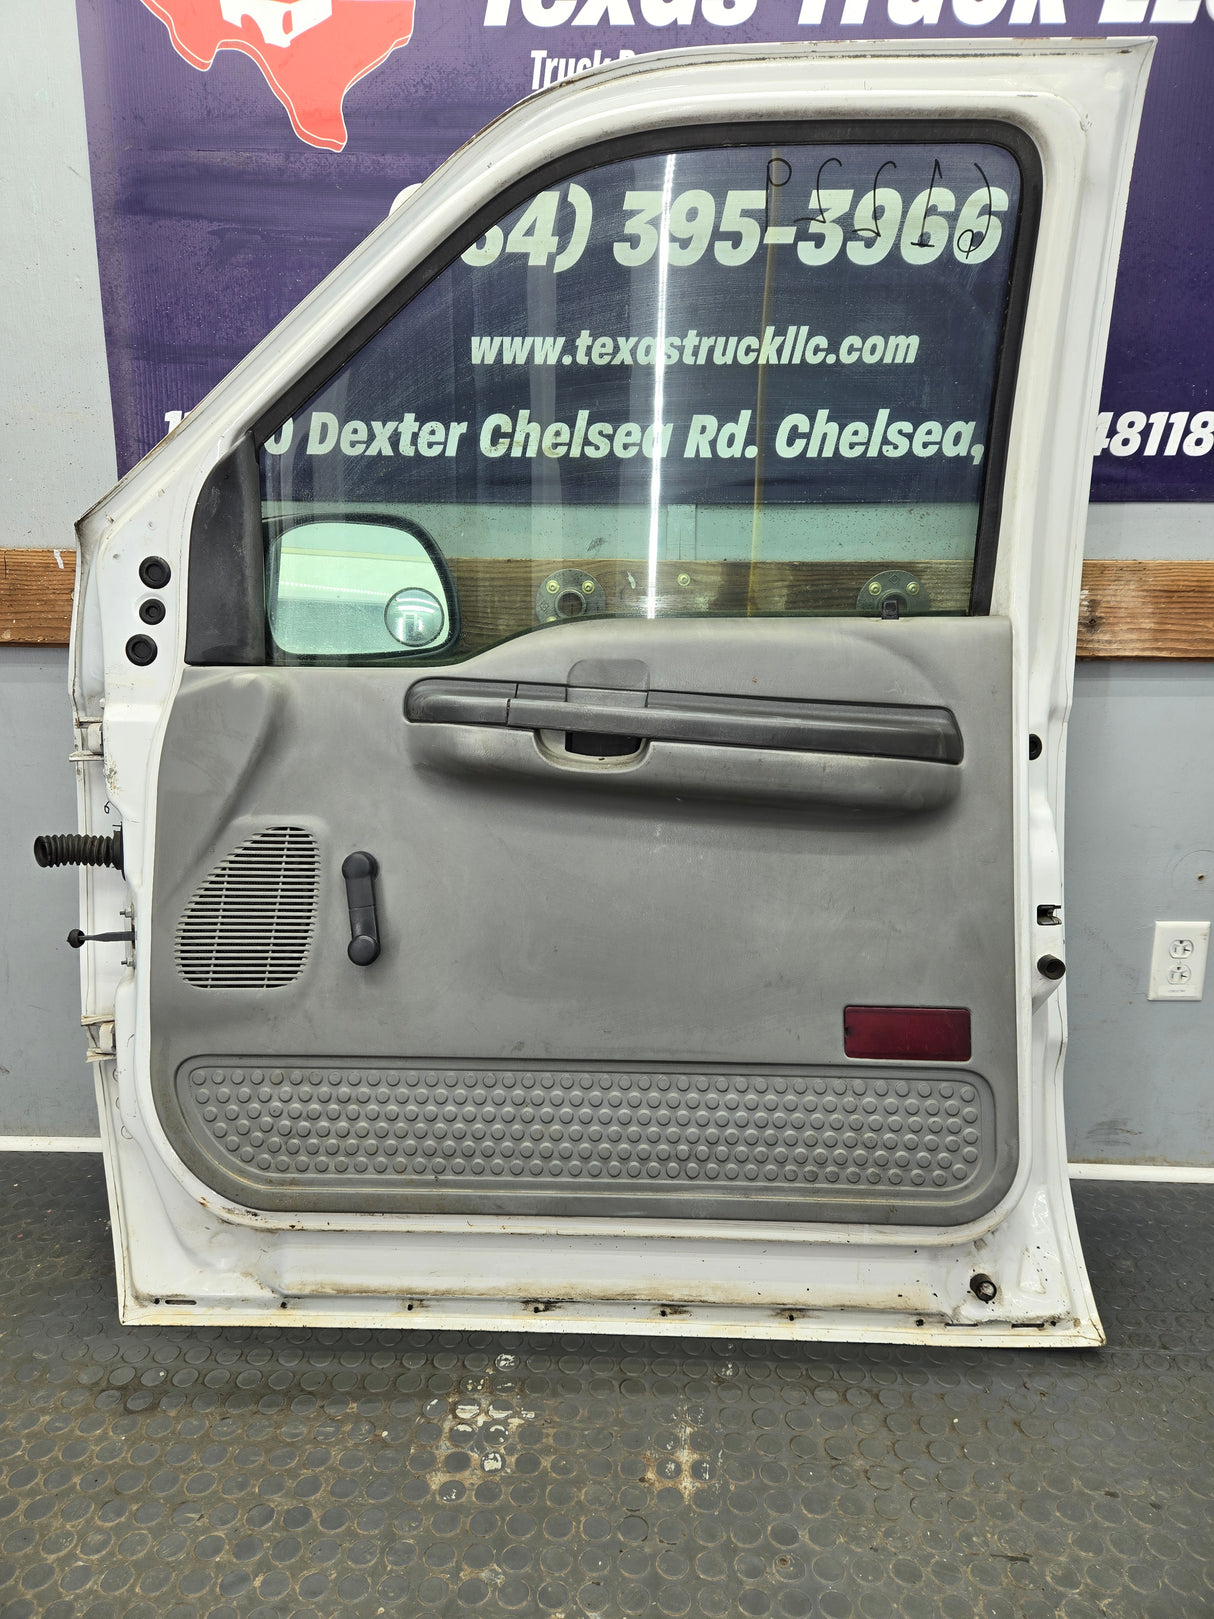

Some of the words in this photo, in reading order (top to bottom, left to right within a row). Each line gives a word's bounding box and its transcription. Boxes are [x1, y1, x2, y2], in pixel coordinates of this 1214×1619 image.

[612, 187, 1010, 266] 395-3966
[471, 327, 920, 365] www.texastruckllc.com
[307, 411, 467, 457] Dexter
[480, 409, 673, 458] Chelsea
[684, 411, 758, 460] Rd.
[776, 408, 985, 465] Chelsea,
